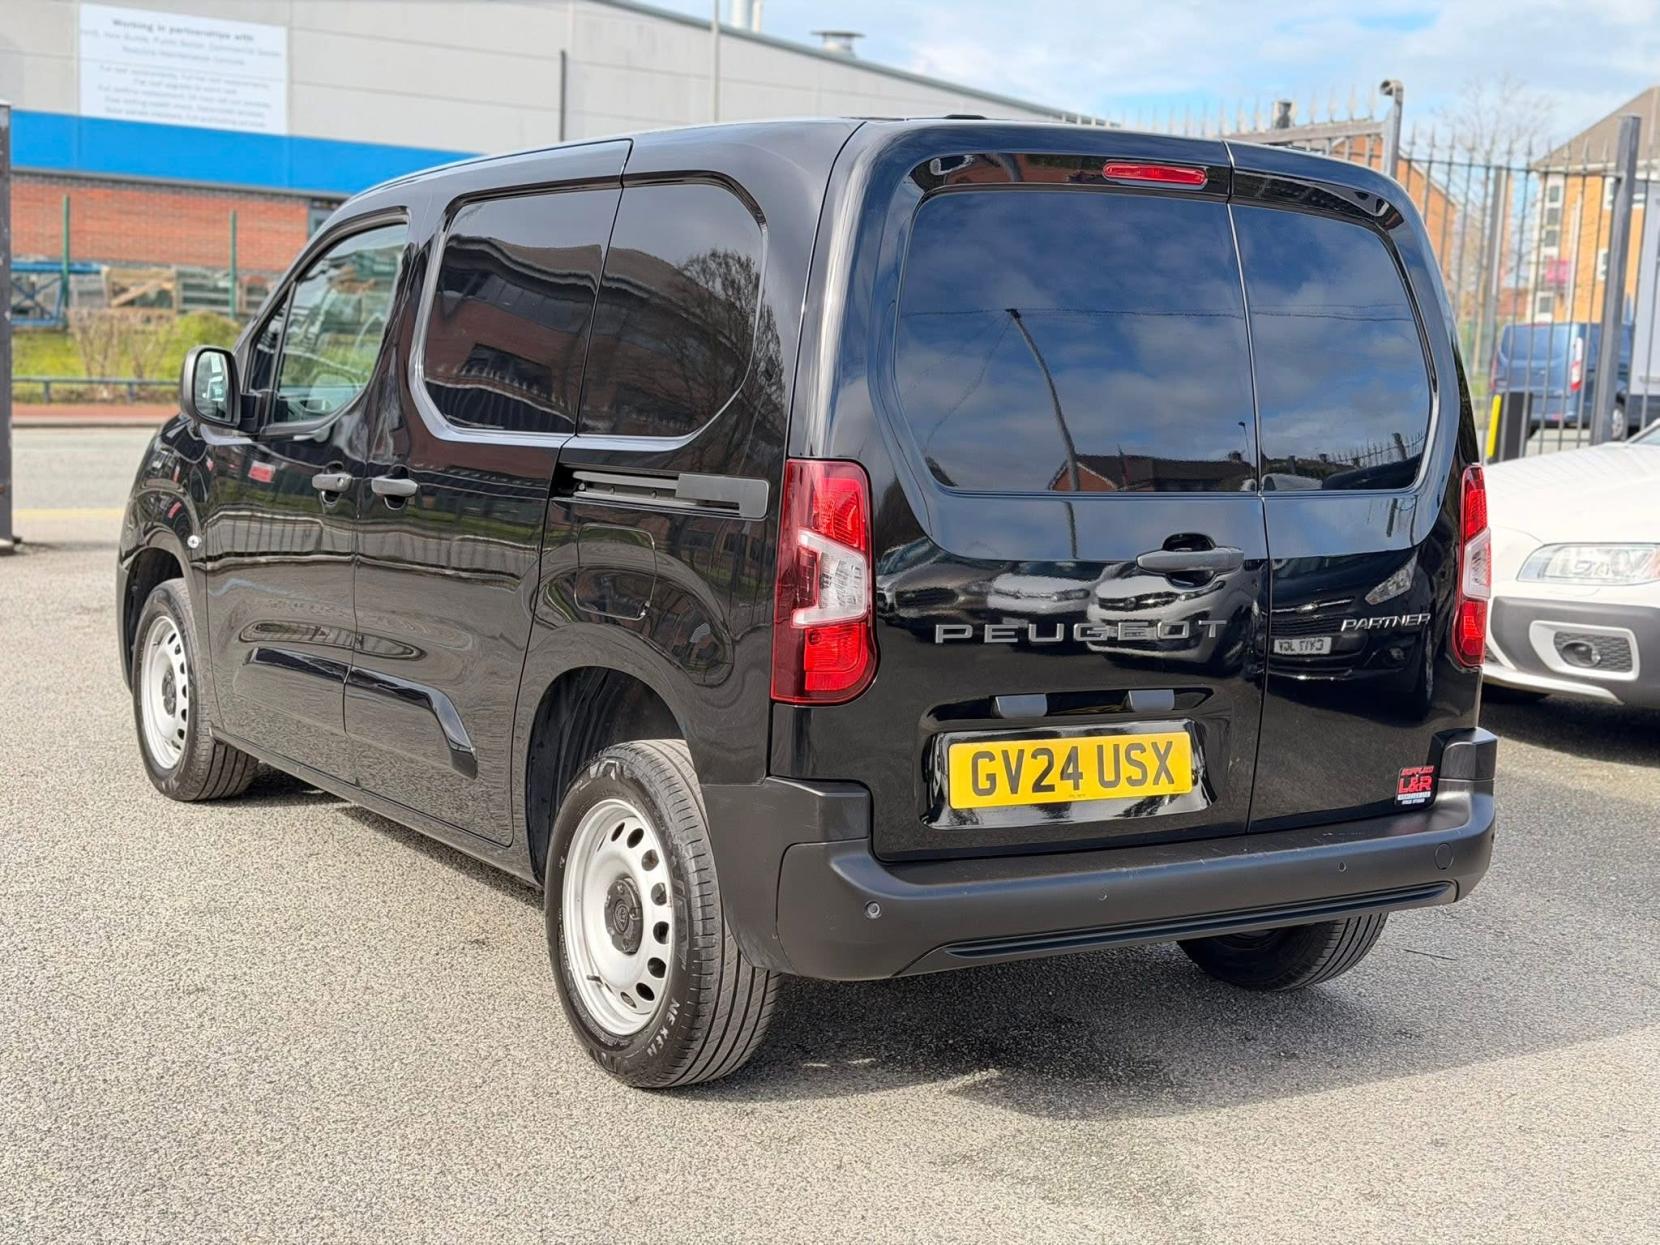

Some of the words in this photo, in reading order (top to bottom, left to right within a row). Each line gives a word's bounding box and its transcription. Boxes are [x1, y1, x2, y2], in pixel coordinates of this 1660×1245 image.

[935, 620, 1226, 644] PEUGEOT
[1341, 613, 1431, 632] PARTNER
[971, 746, 1083, 796] GV24
[1096, 741, 1175, 788] USX
